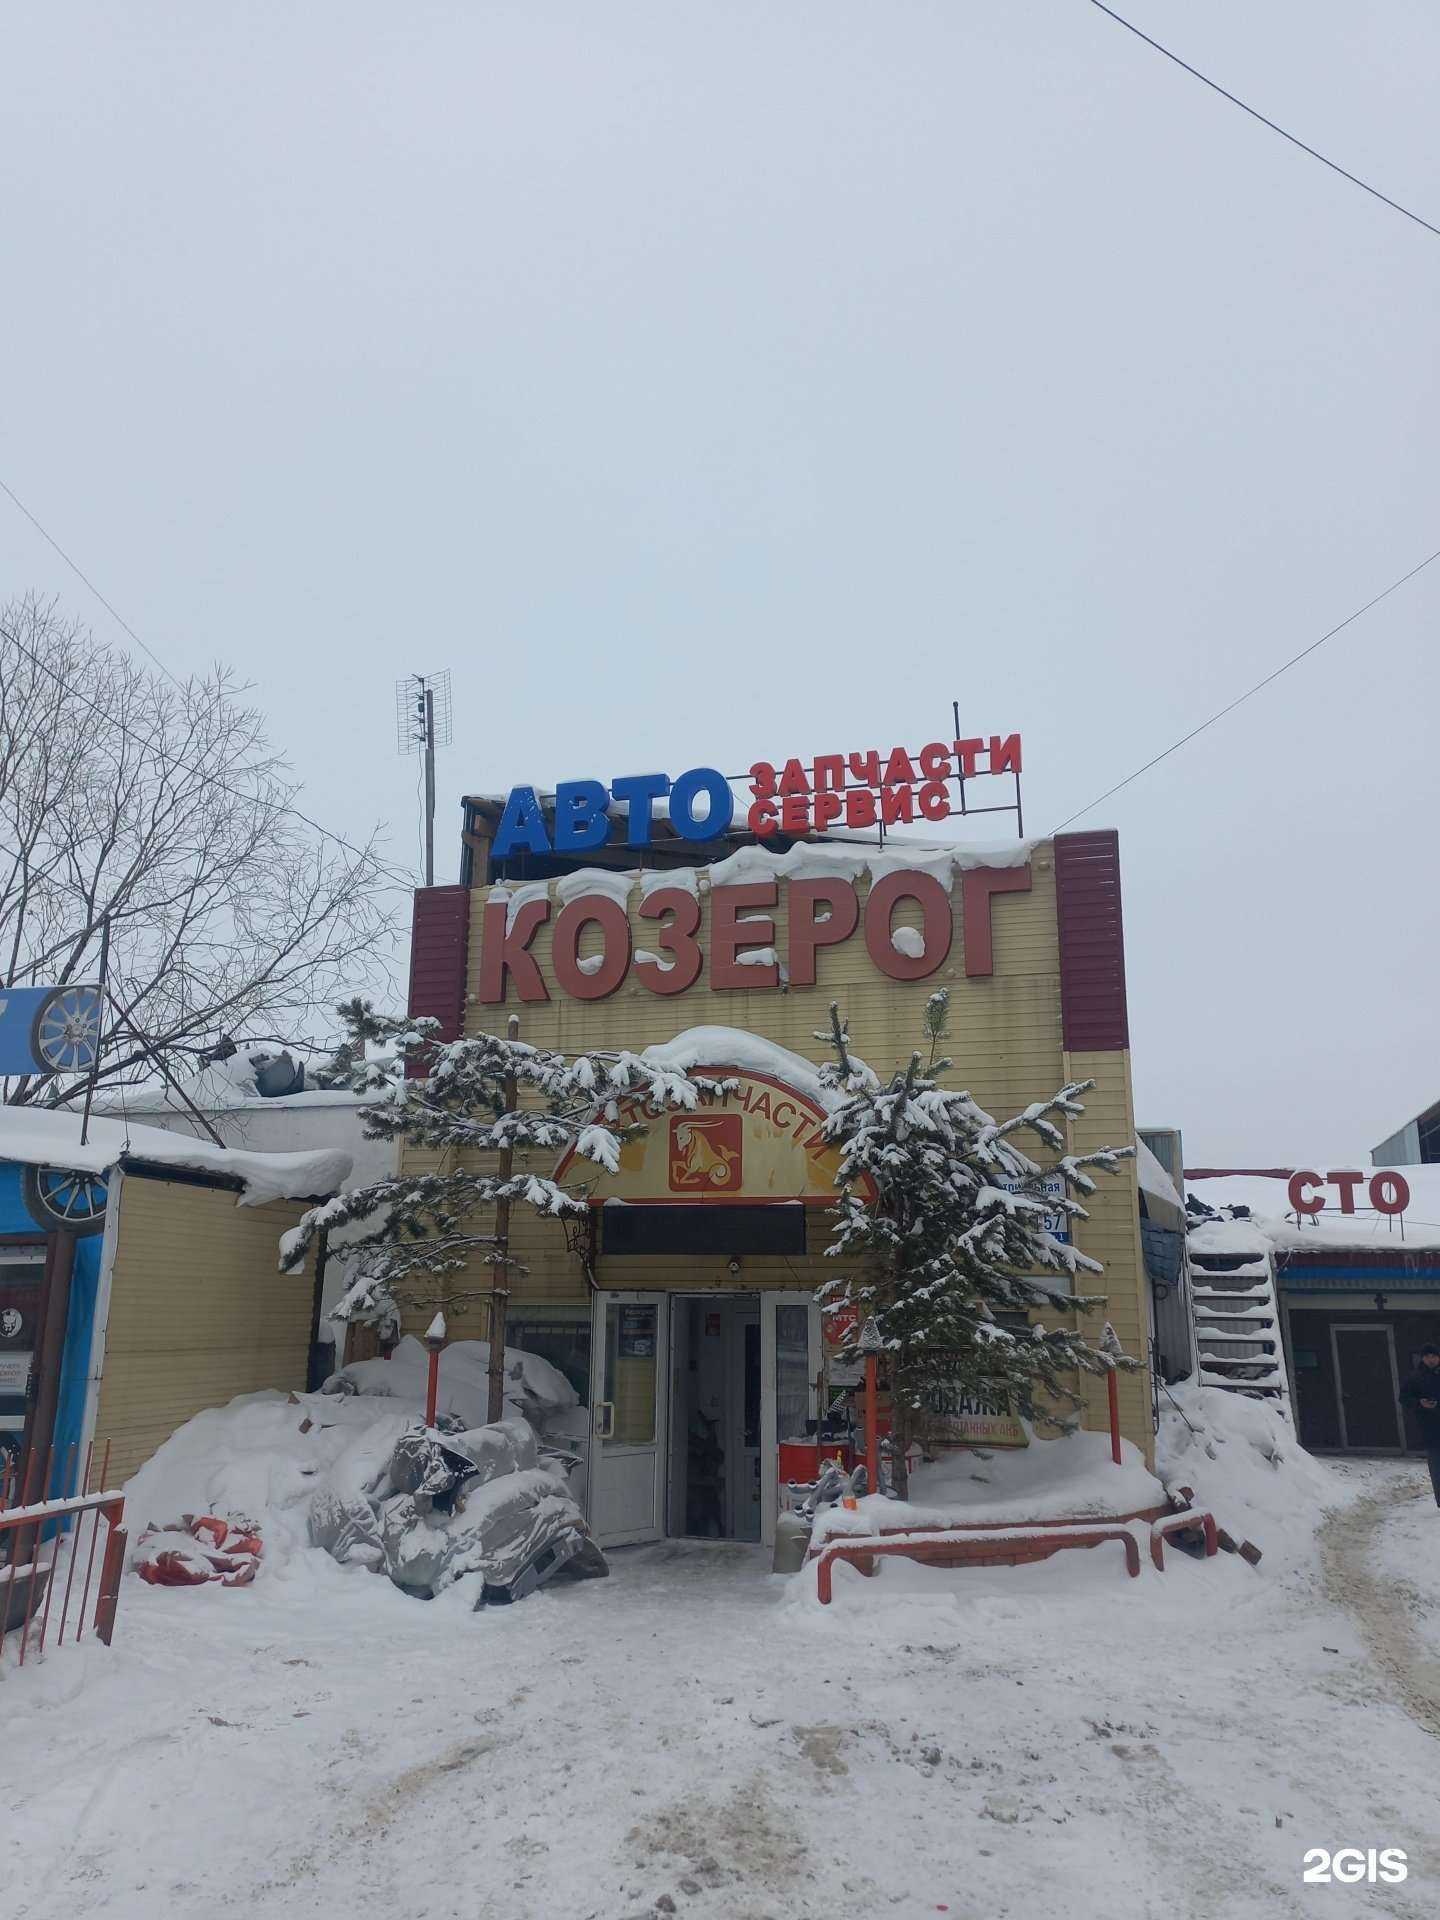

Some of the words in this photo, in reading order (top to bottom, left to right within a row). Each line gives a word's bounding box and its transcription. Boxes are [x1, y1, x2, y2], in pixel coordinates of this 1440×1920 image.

[749, 734, 1022, 799] ЗАПЧАСТИ
[490, 767, 734, 859] АВТО
[748, 781, 951, 837] СЕРВИС
[479, 867, 1032, 1004] КОЗЕРОГ
[1288, 1171, 1410, 1215] СТО
